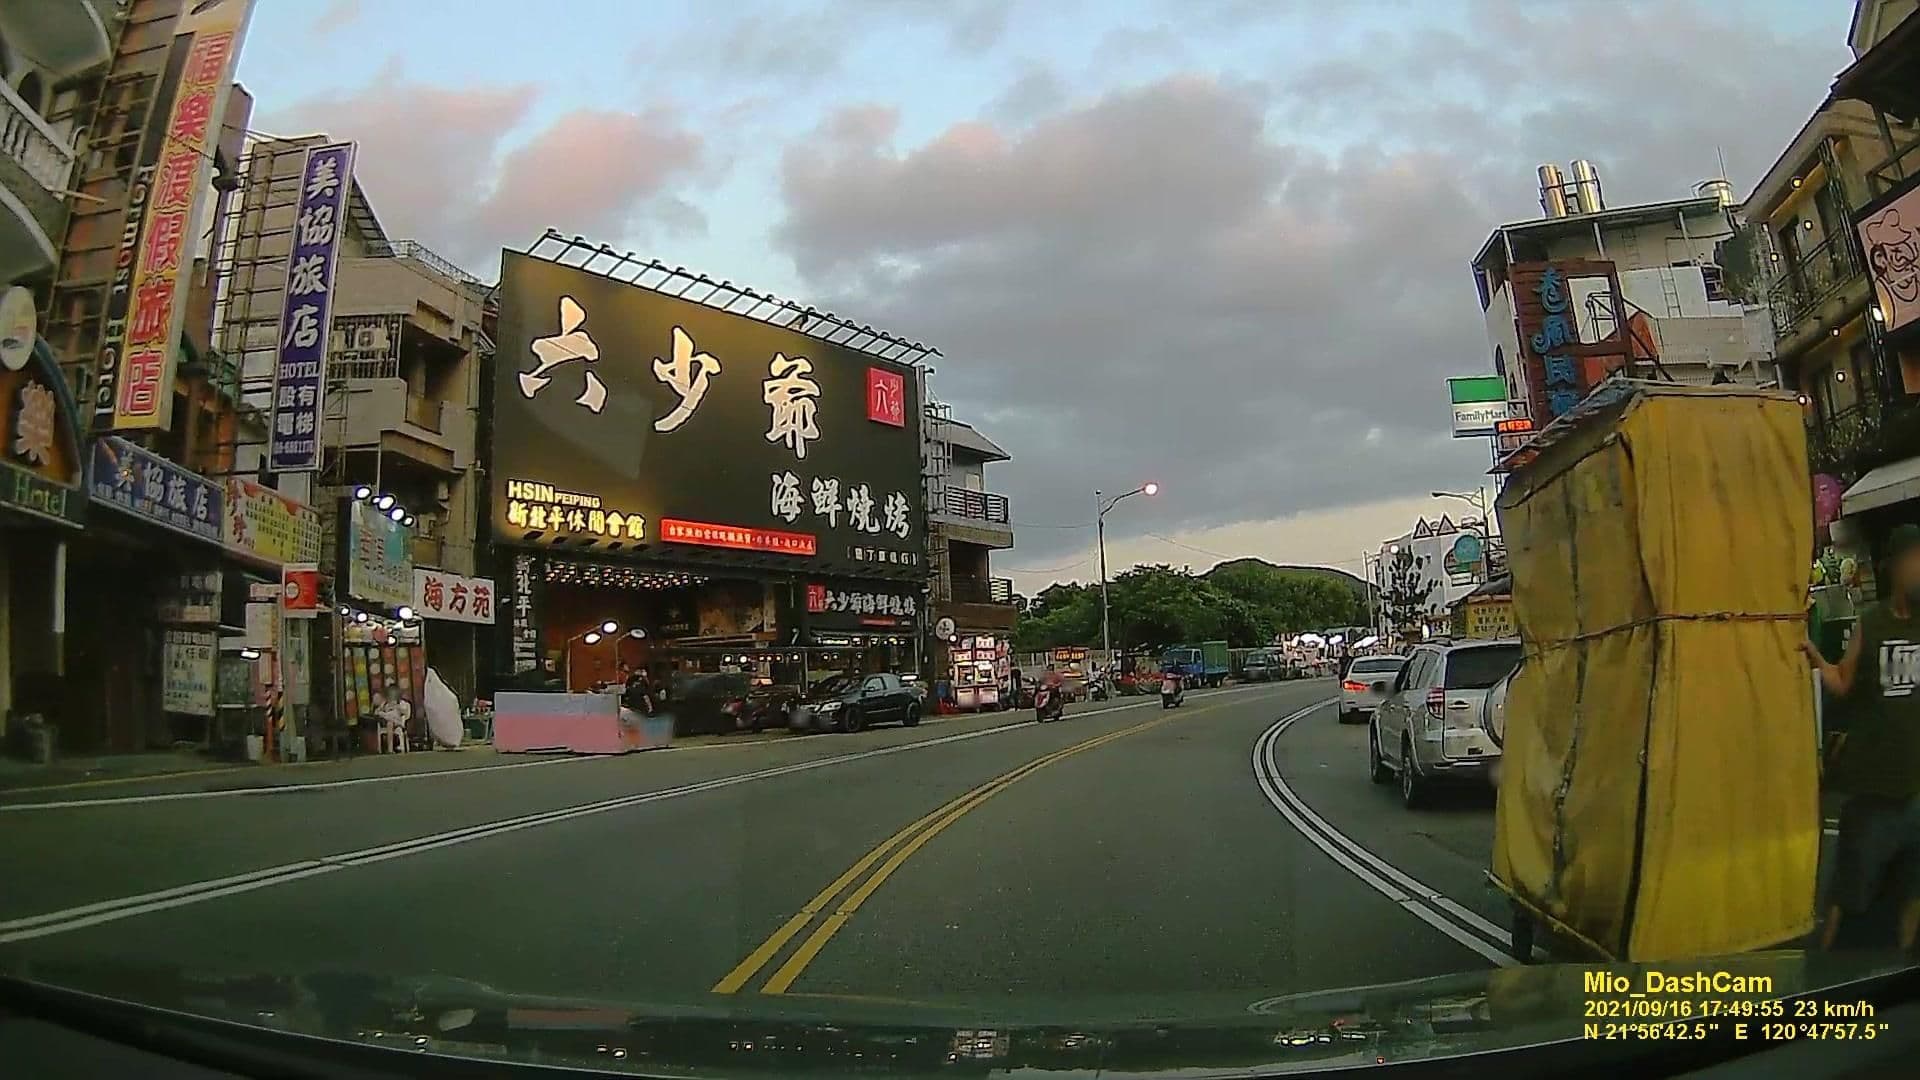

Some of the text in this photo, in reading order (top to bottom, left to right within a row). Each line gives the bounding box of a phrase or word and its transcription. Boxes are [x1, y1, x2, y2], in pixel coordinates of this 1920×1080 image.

[283, 157, 341, 351] 美協旅店
[96, 318, 127, 416] Hotel
[280, 362, 319, 379] HOTEL
[519, 296, 821, 459] 六少爺
[1455, 409, 1507, 424] FamilyMart
[15, 473, 67, 517] Hotel
[508, 480, 601, 509] HSIN PEIPING
[770, 470, 911, 540] 海鮮燒烤
[423, 575, 490, 618] 海方苑
